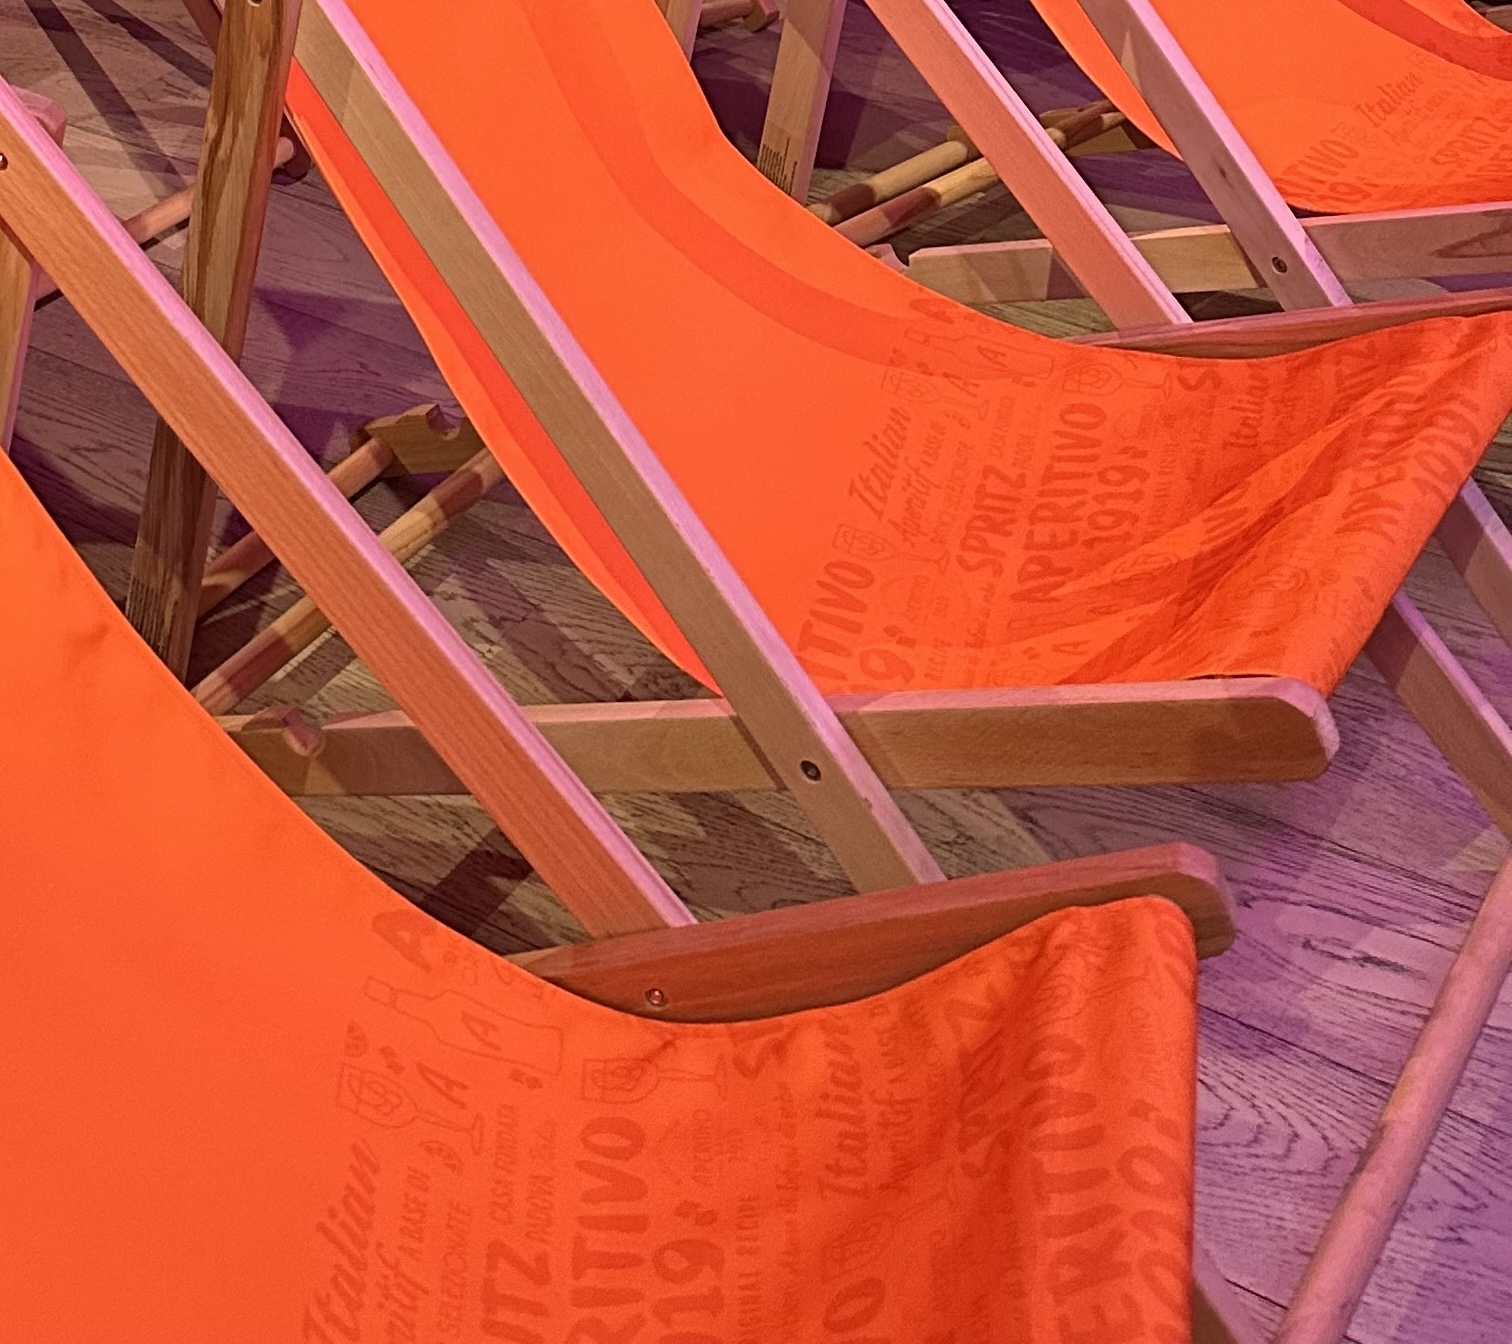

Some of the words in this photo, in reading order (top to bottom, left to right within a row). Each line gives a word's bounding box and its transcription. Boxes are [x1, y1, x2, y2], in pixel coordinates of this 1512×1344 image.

[848, 406, 913, 522] Italian
[955, 464, 1027, 579] SPRITZ
[1008, 402, 1108, 604] APERITIVO
[1081, 464, 1149, 550] 1919
[814, 1012, 871, 1200] Italian
[302, 1137, 382, 1344] Italian
[399, 1194, 428, 1244] BASE
[489, 1177, 516, 1226] CASA
[564, 1115, 649, 1344] RITIVO
[479, 1239, 552, 1344] ITZ
